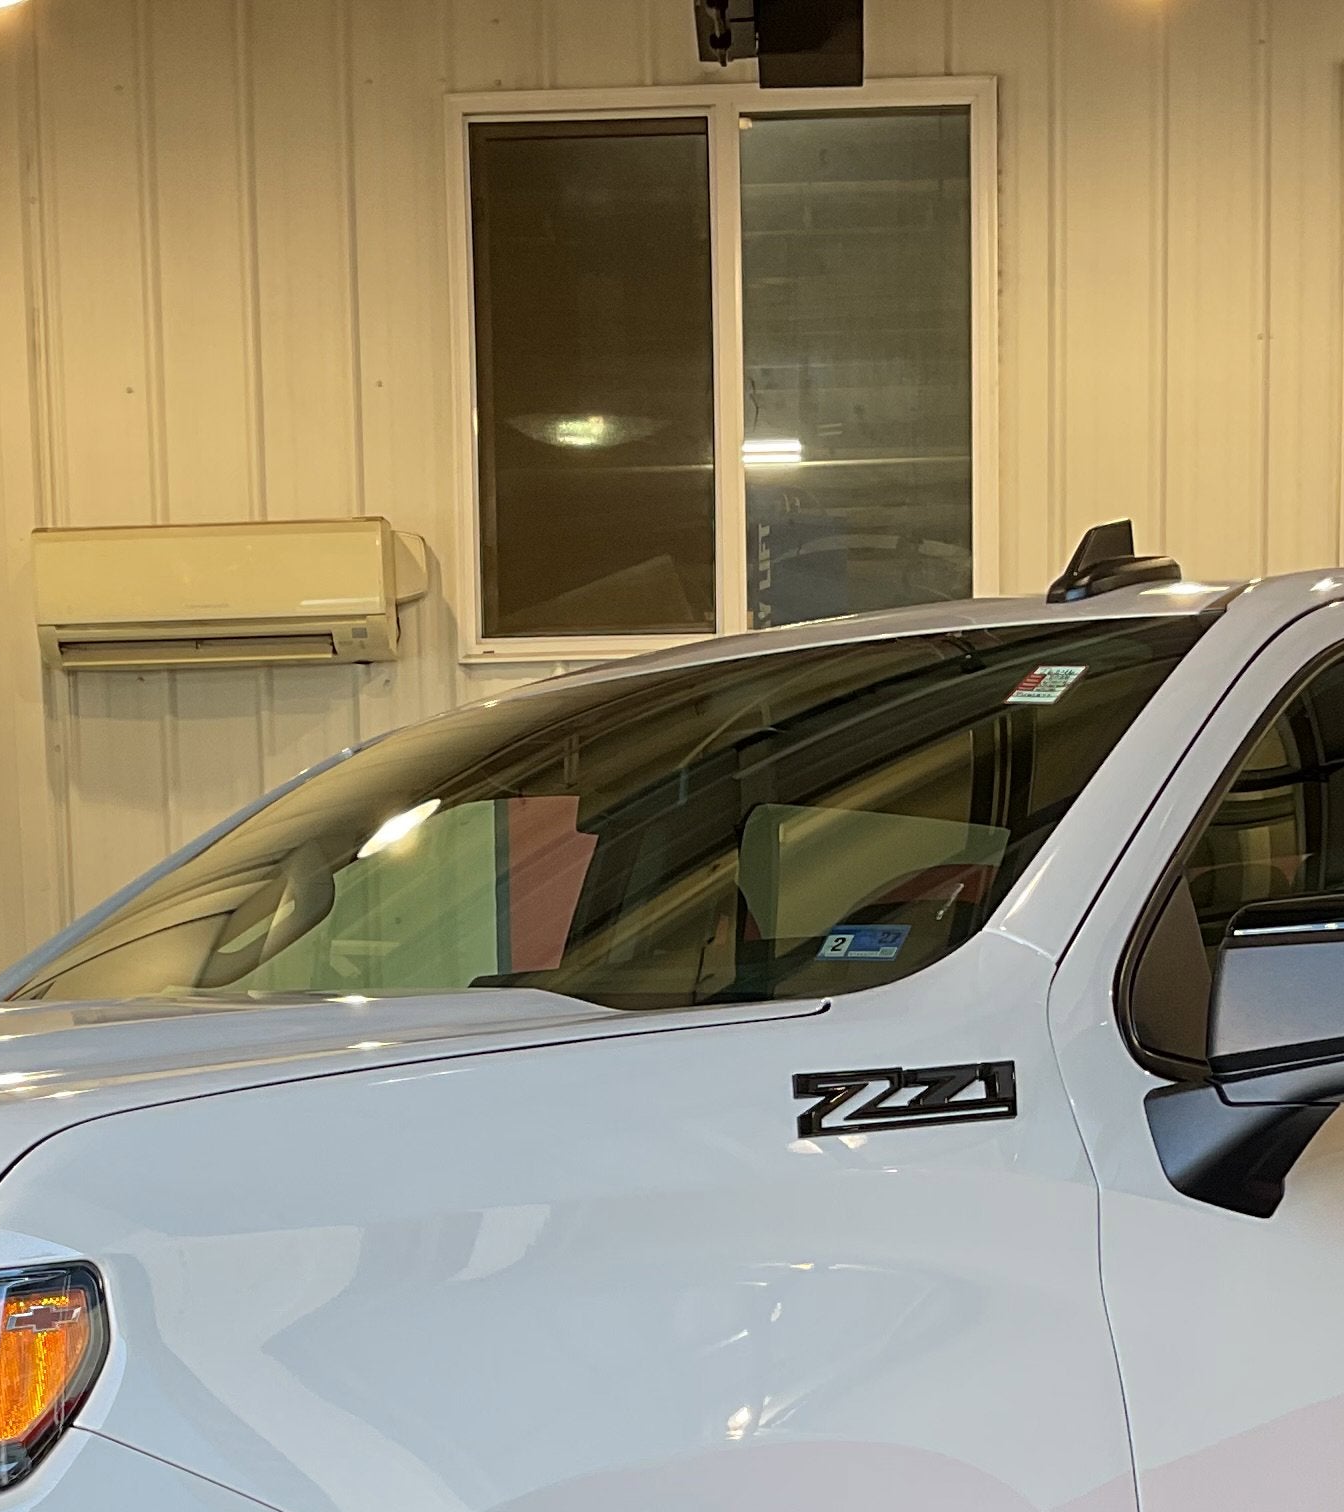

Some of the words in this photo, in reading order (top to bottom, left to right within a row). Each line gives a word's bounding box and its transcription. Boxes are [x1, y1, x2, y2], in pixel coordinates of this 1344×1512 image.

[758, 523, 771, 591] LIFT
[830, 937, 847, 952] 2
[878, 931, 903, 944] 27
[792, 1060, 1018, 1139] Z71
